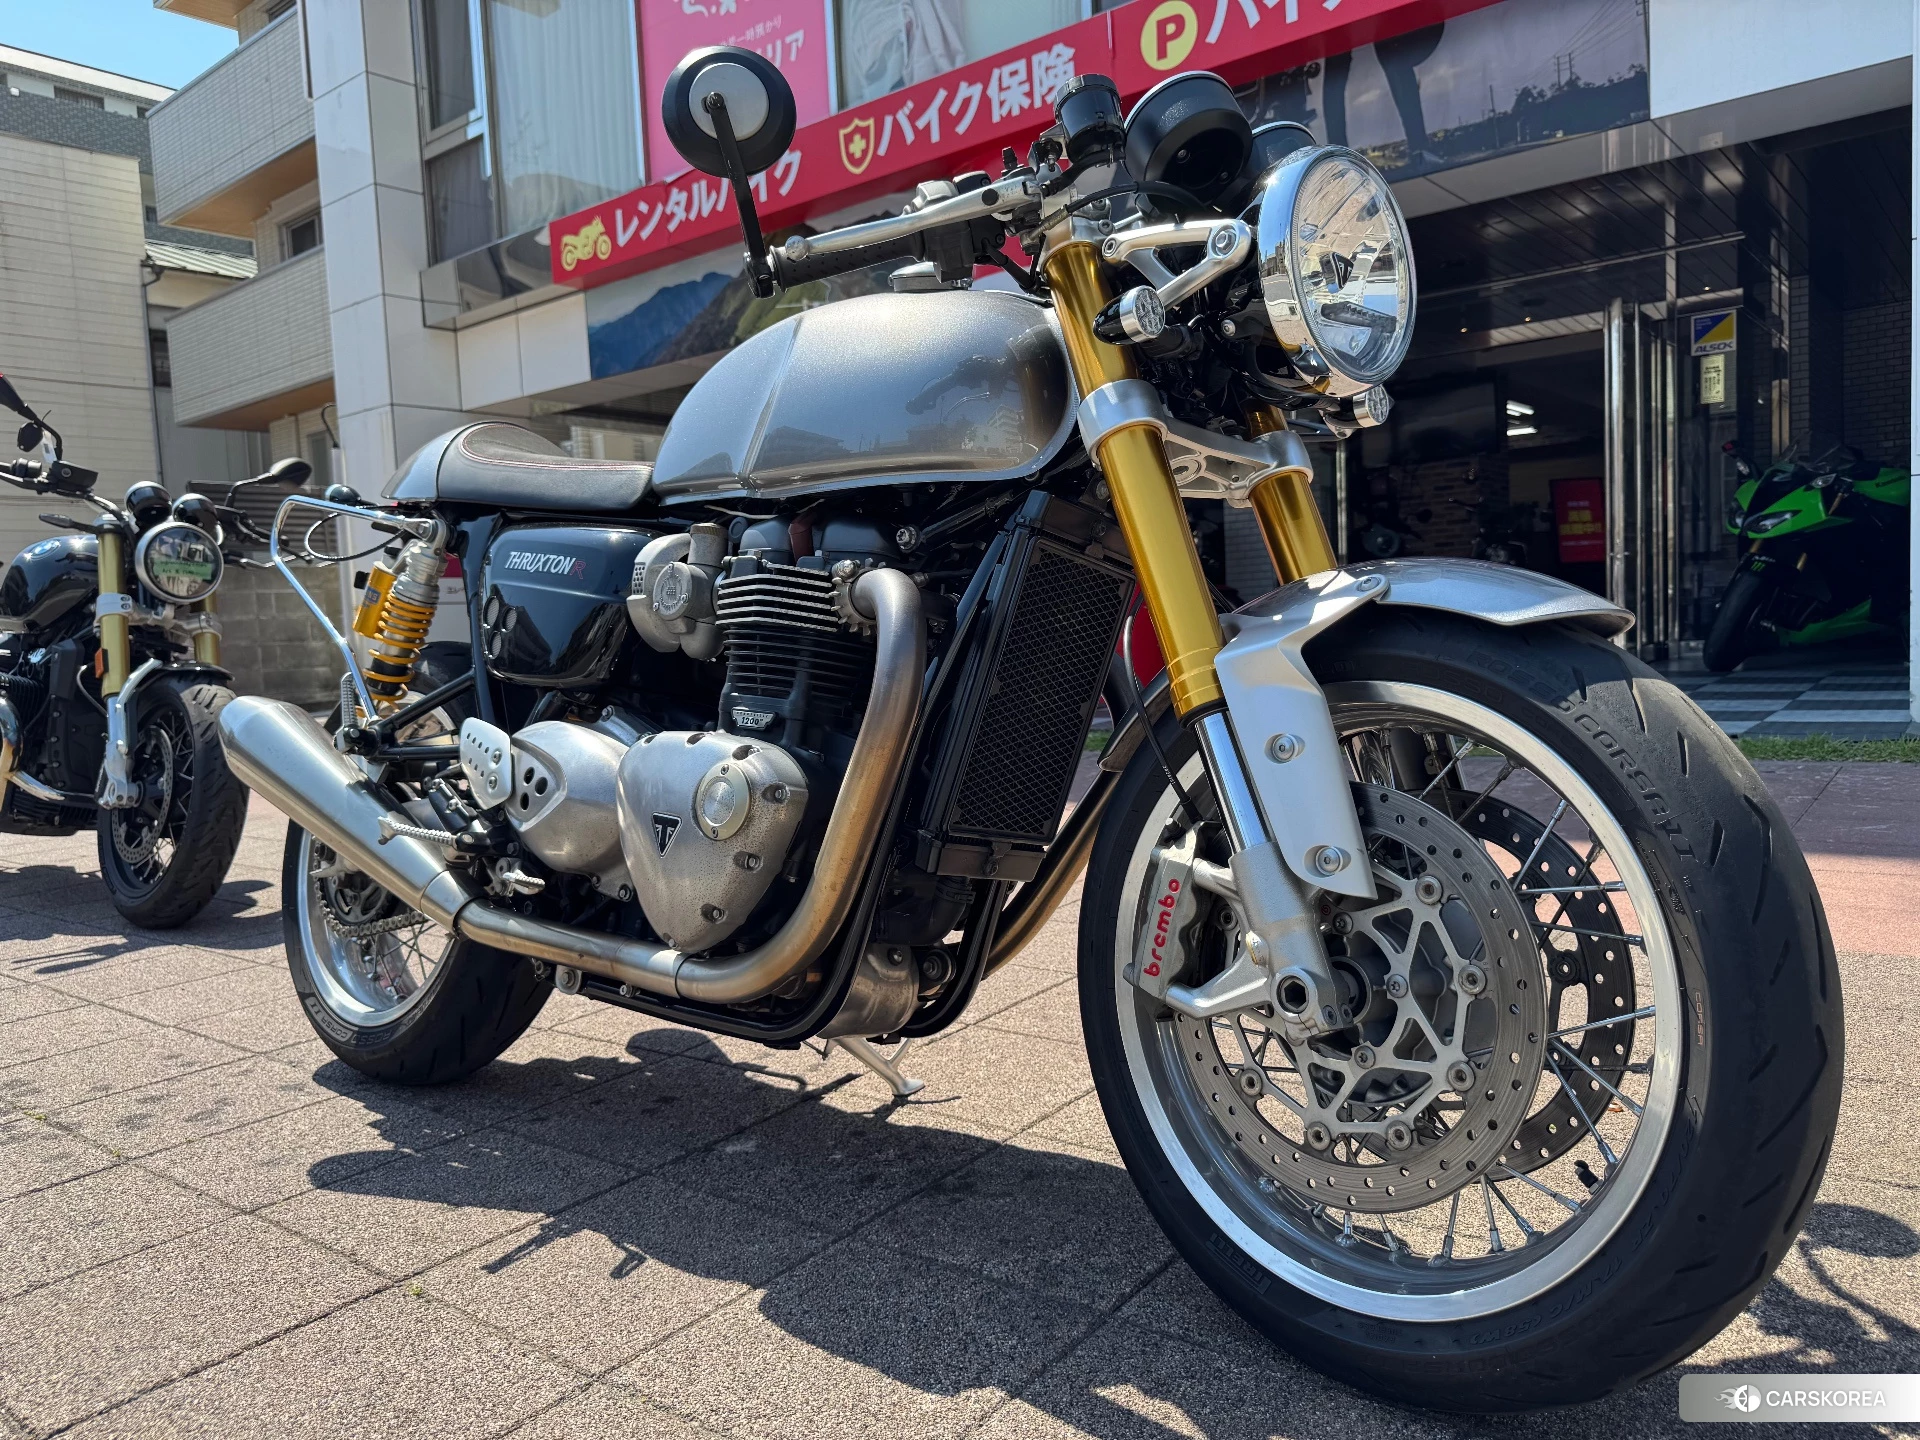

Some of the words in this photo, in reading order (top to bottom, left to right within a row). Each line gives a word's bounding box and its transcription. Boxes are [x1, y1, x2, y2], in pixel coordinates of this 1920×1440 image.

[877, 41, 1076, 157] バイク保険
[504, 551, 577, 575] THRUXTON
[1143, 878, 1181, 977] brembo
